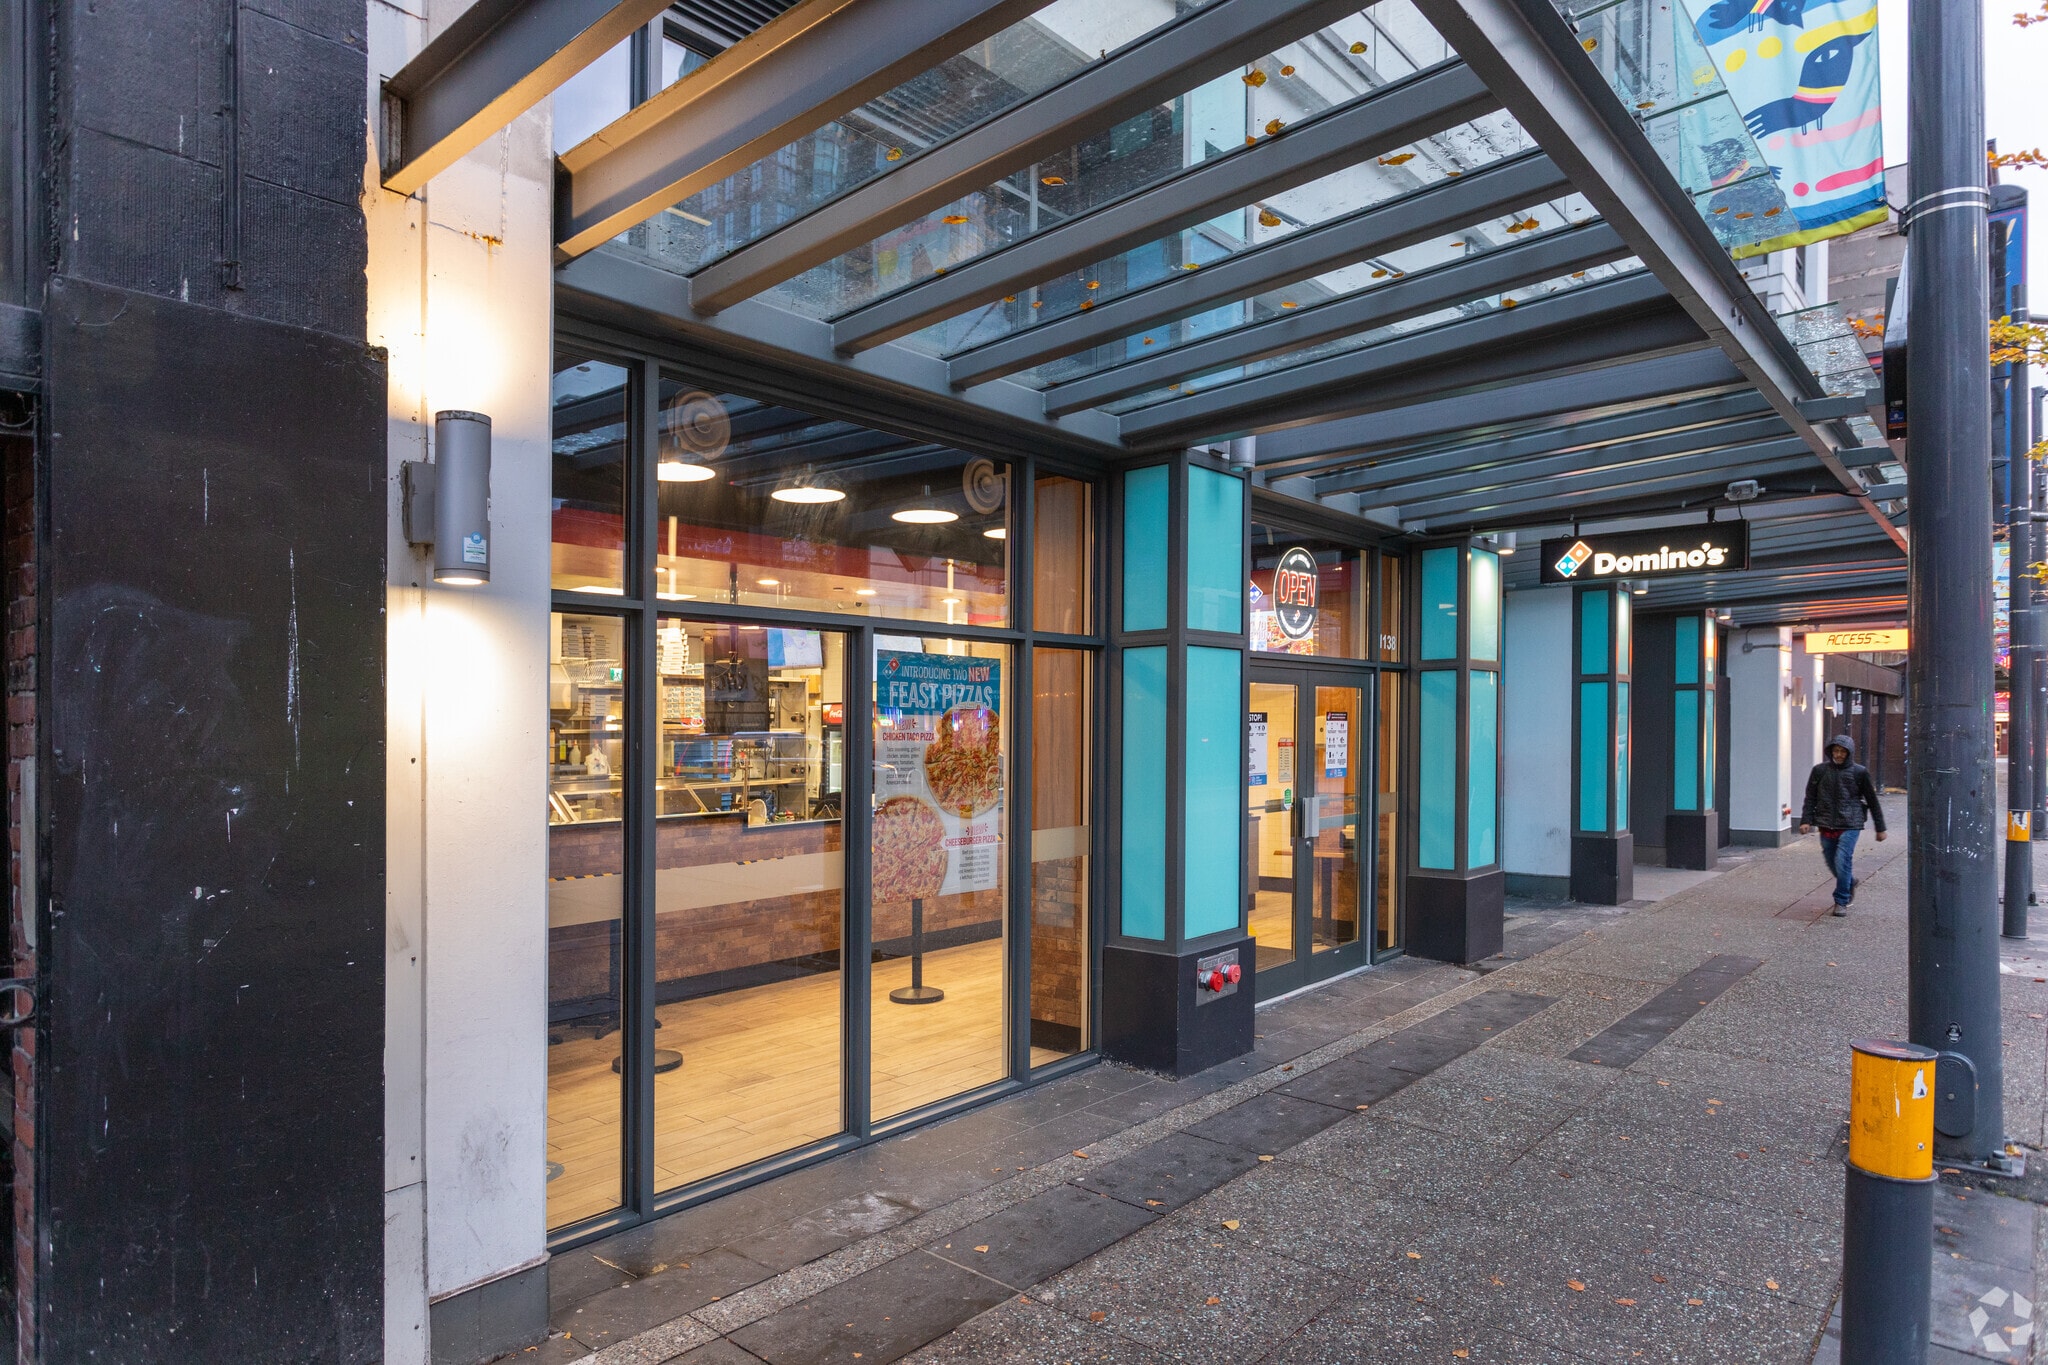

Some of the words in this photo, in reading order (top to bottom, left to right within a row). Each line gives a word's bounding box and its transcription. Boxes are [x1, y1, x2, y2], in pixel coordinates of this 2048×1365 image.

[1594, 542, 1725, 575] Domino's
[1279, 569, 1316, 608] OPEN
[1827, 634, 1872, 645] ACCESS
[901, 665, 951, 680] INTRODUCING
[953, 669, 968, 681] TWO
[968, 666, 990, 682] NEW
[889, 681, 939, 709] FEAST
[942, 684, 993, 711] PIZZAS
[883, 732, 906, 741] CHICKEN
[906, 732, 920, 742] TACO
[920, 732, 935, 741] PIZZA
[944, 835, 983, 847] CHEESEBURGER
[982, 834, 996, 844] PIZZA
